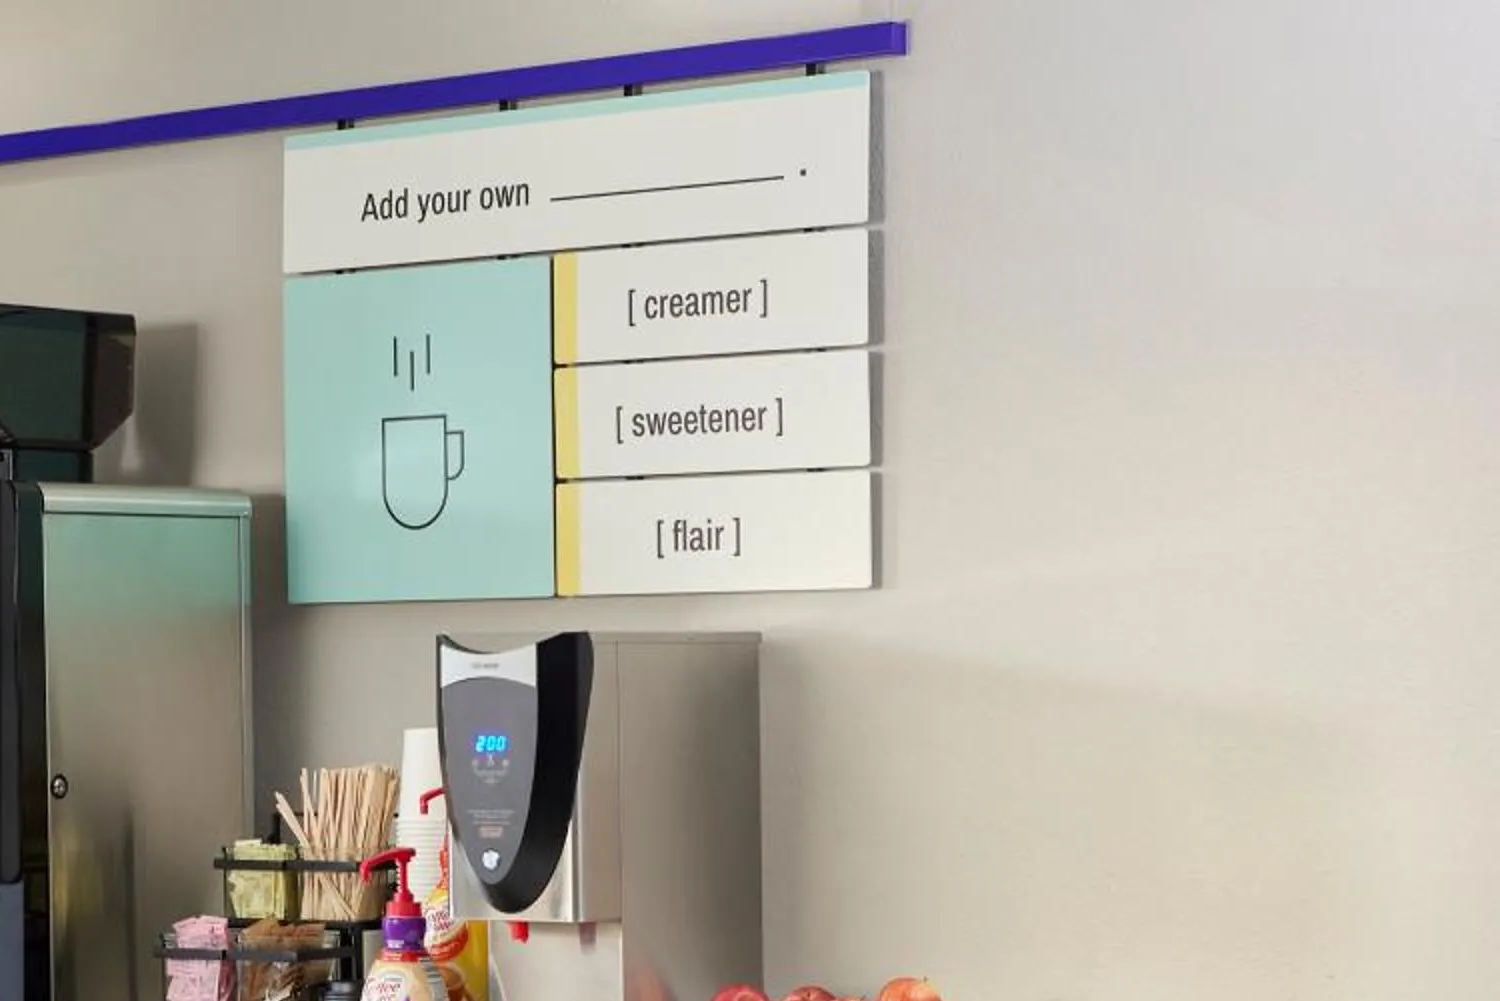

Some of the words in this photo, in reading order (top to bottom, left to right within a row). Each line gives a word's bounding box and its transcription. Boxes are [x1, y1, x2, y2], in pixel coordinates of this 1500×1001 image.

[360, 187, 410, 222] Add
[416, 188, 472, 223] your
[479, 182, 531, 211] own
[475, 734, 508, 753] 200
